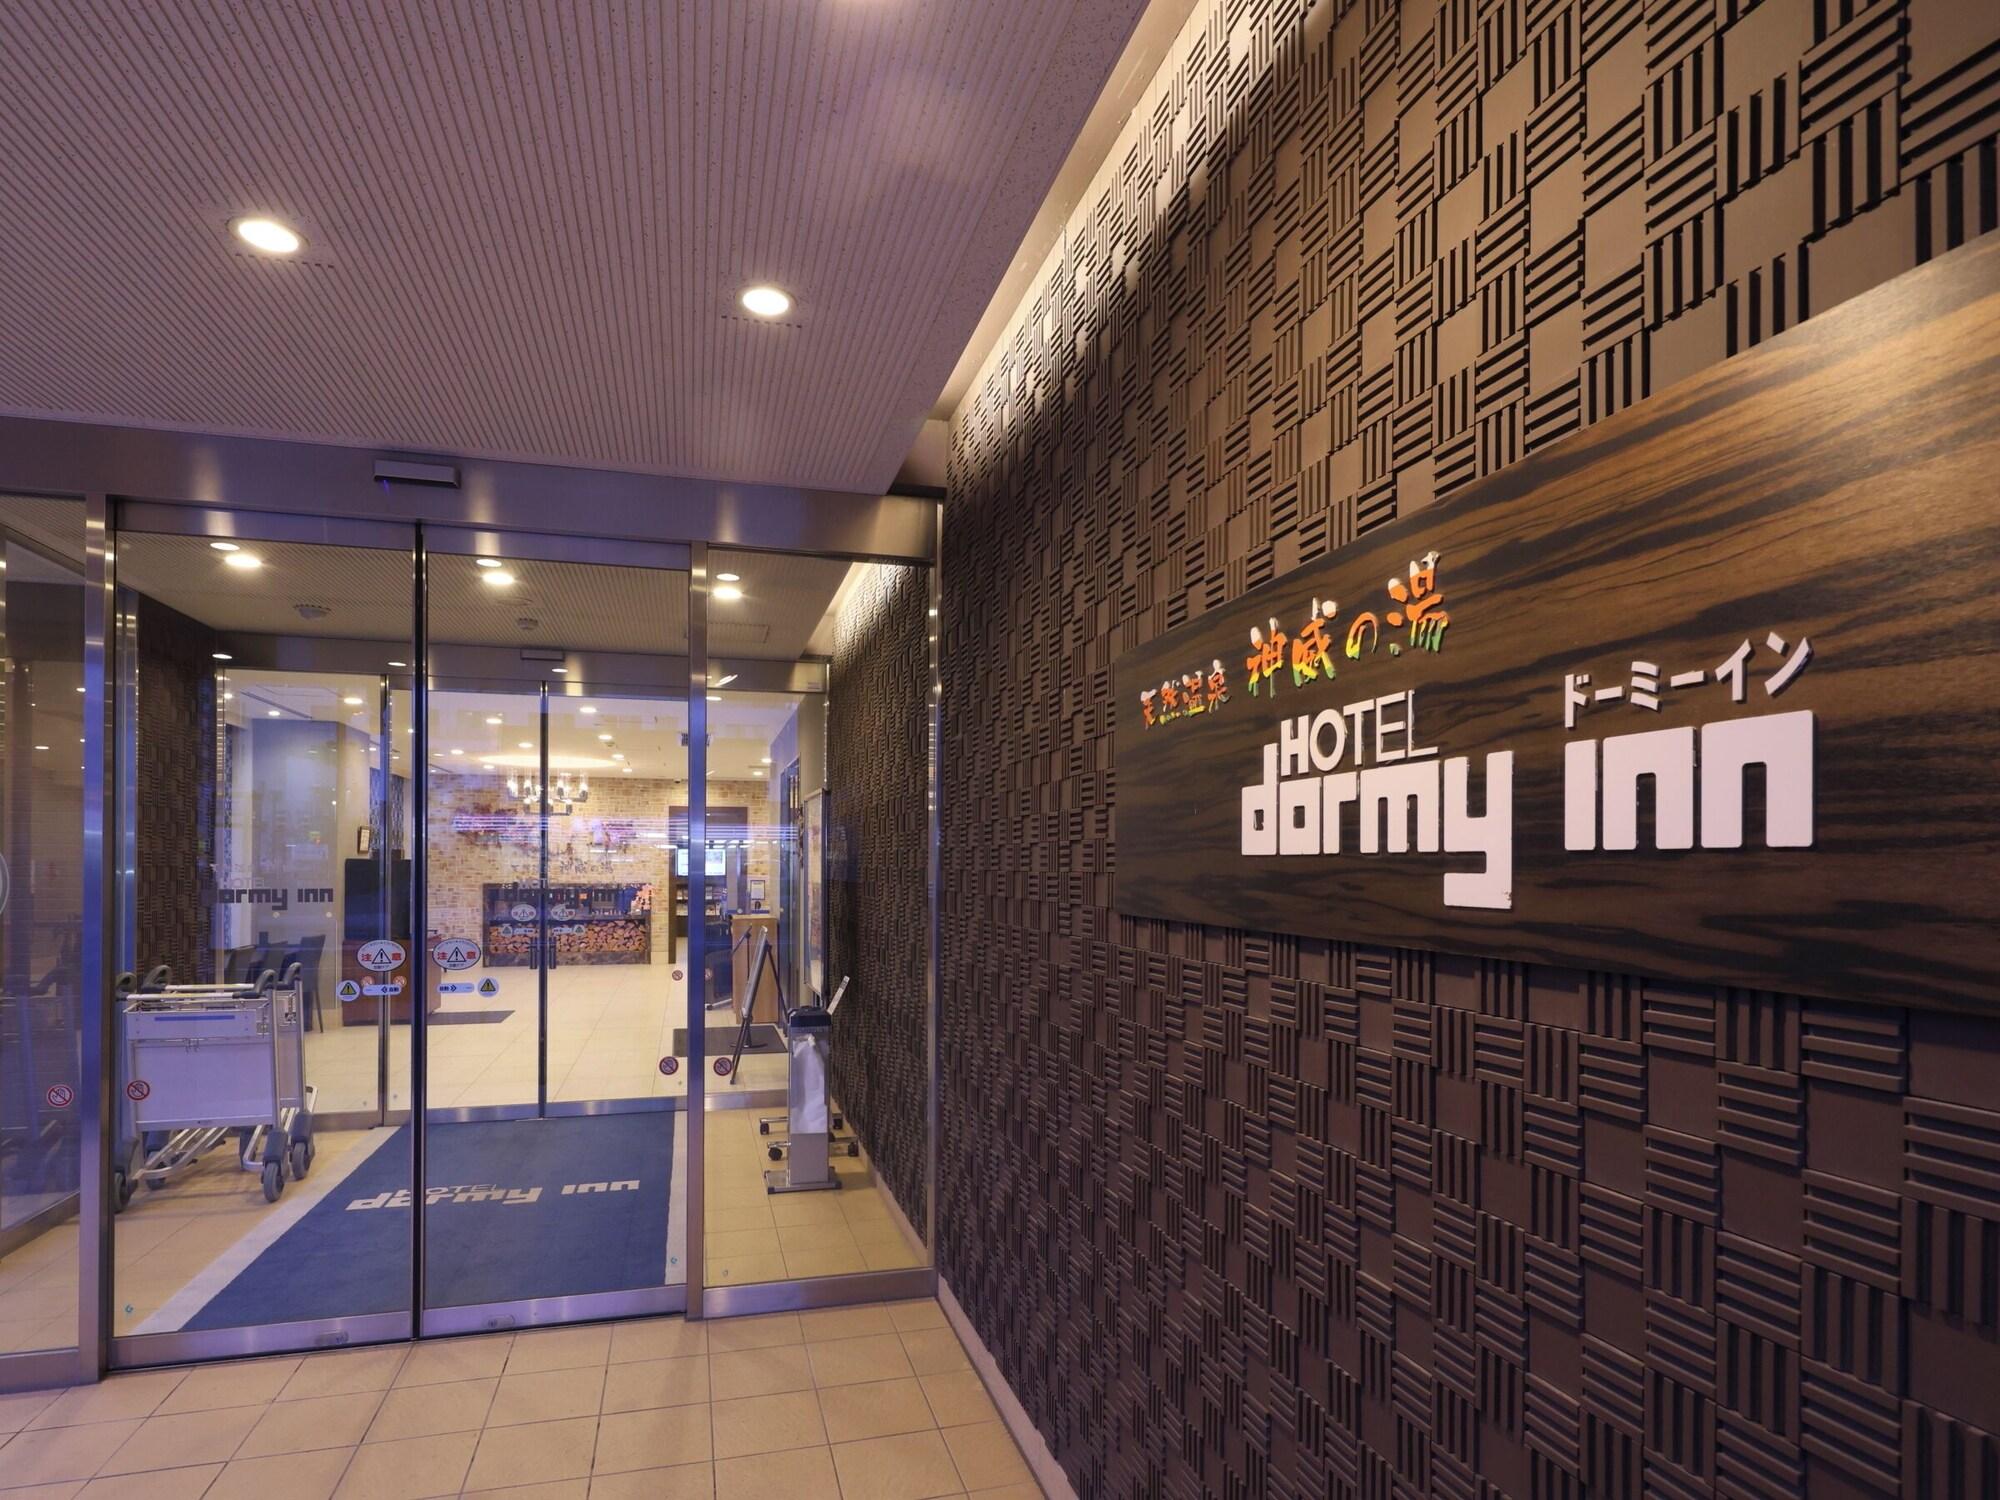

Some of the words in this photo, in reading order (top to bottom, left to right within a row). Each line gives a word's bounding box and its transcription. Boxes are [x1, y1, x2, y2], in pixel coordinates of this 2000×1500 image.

[1247, 551, 1449, 699] 神威の湯
[1564, 631, 1813, 728] ドーミーイン
[1280, 689, 1439, 776] HOTEL
[1241, 743, 1513, 910] dormy
[1564, 709, 1814, 850] inn
[297, 888, 334, 902] inn
[560, 1180, 641, 1195] inn
